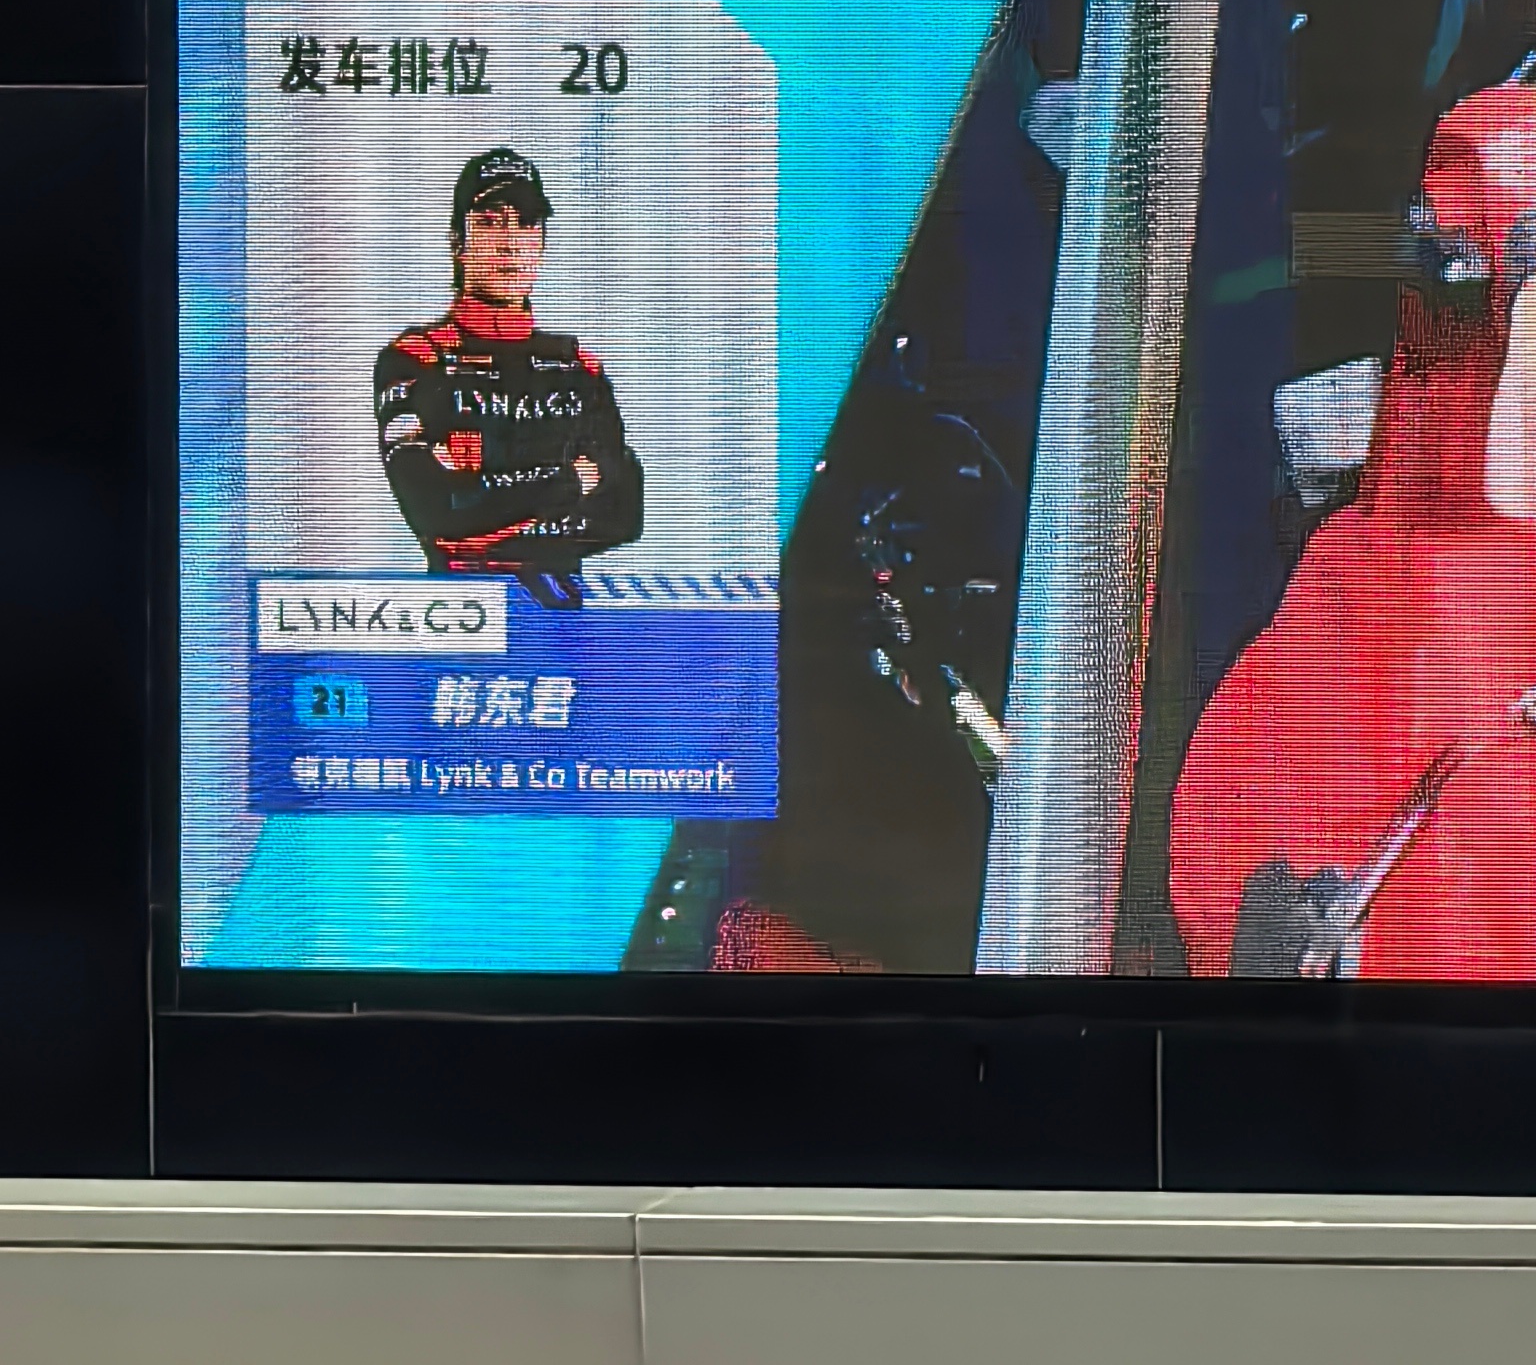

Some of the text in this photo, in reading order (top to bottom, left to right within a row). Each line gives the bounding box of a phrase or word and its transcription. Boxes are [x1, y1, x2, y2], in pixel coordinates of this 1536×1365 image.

[278, 34, 630, 96] 发车排位 20
[311, 684, 348, 718] 21
[421, 759, 492, 795] Lynk
[528, 760, 566, 790] Co
[575, 759, 736, 793] Teamwork
